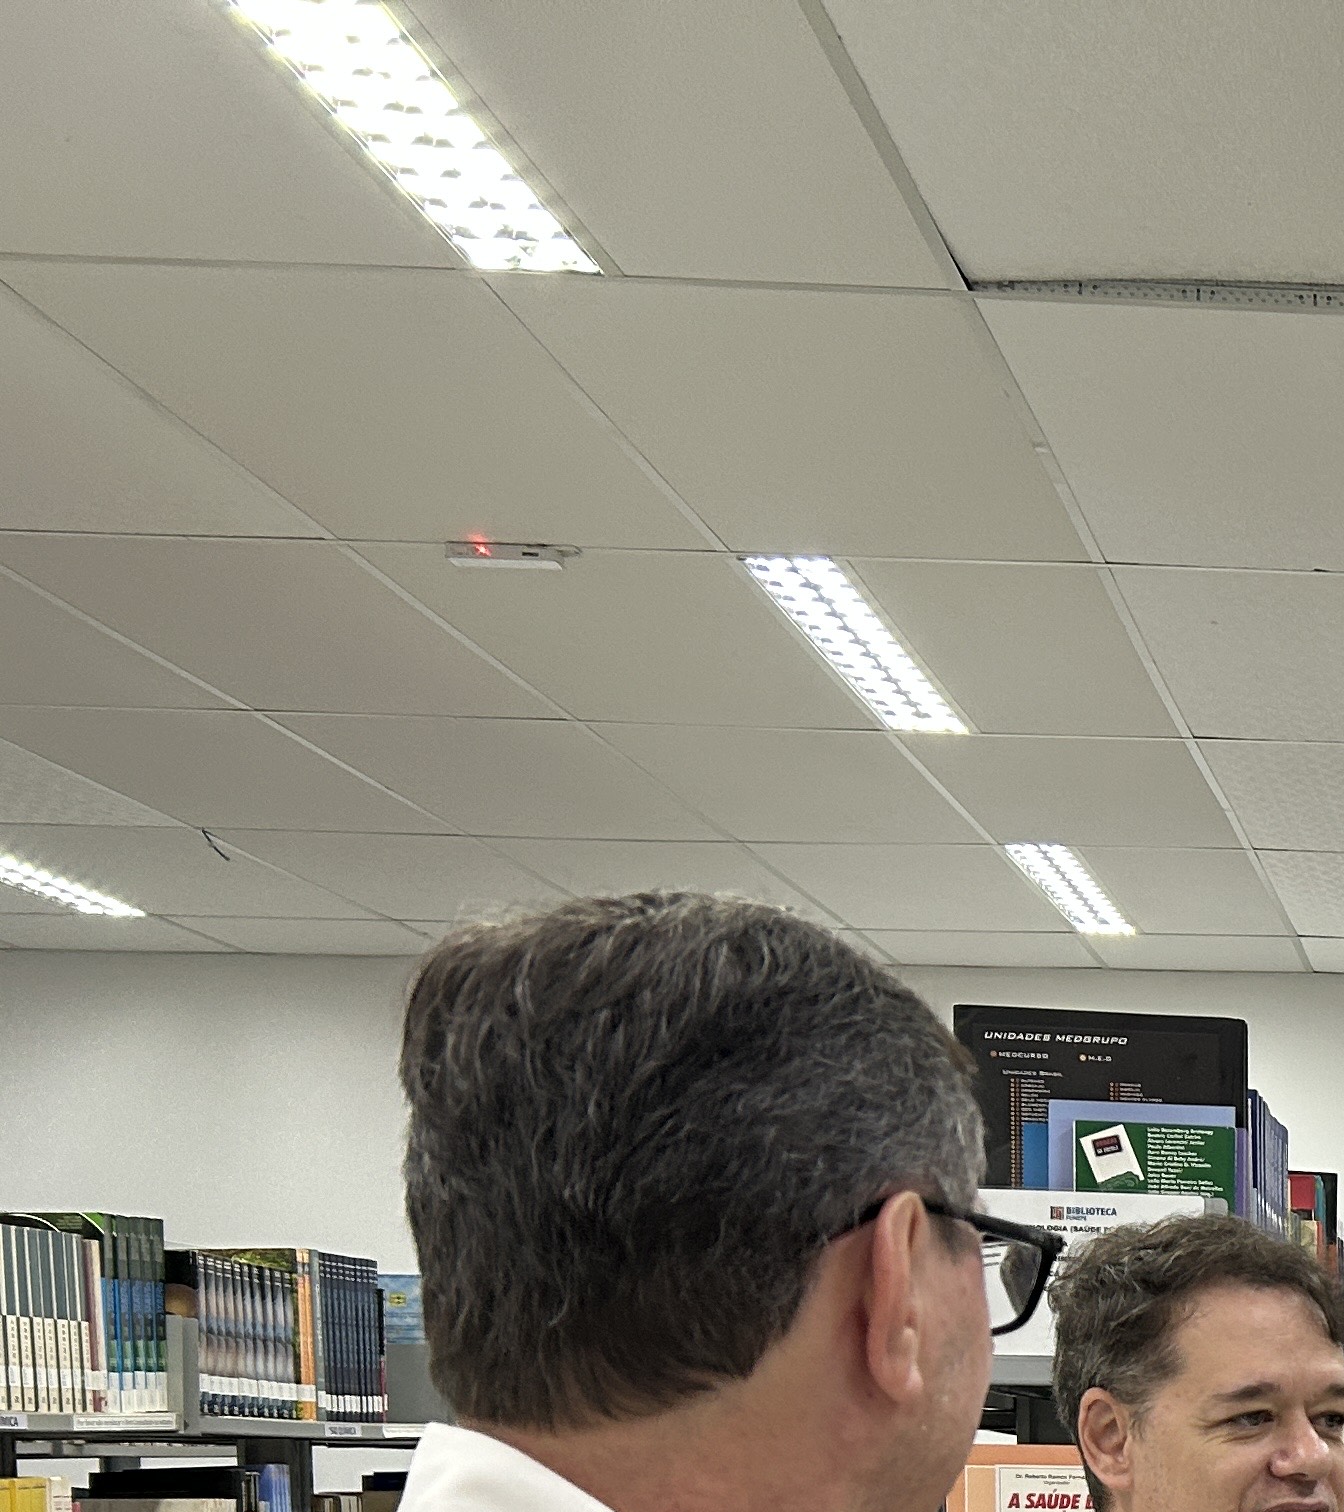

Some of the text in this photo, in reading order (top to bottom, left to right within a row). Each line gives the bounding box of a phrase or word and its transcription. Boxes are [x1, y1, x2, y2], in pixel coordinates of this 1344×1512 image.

[984, 1031, 1051, 1042] UNIDADES
[1066, 1206, 1117, 1217] BIBLIOTECA
[1007, 1493, 1020, 1509] A
[1025, 1488, 1081, 1509] SAÚDE
